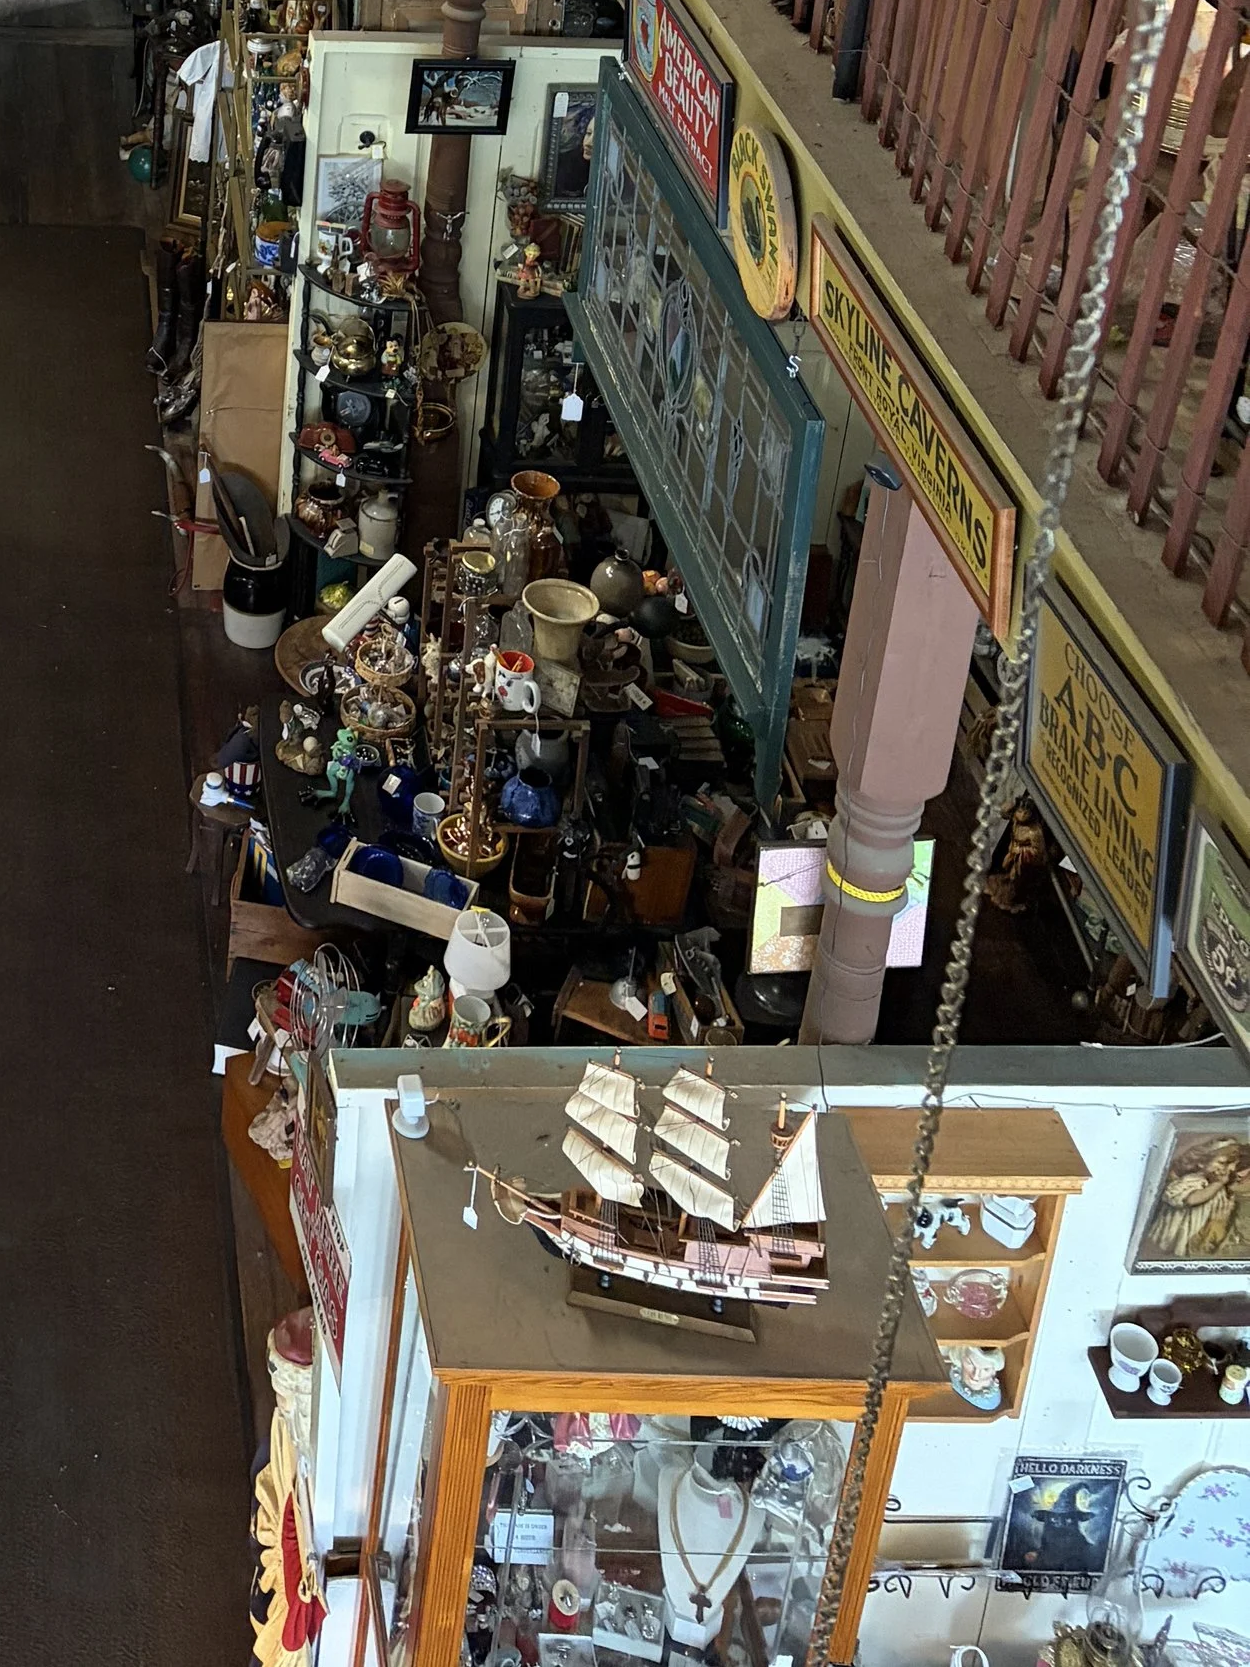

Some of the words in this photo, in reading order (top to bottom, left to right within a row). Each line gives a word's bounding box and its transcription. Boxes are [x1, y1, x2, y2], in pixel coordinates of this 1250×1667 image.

[657, 81, 675, 120] MALT
[676, 110, 713, 181] EXTRACT
[658, 7, 720, 127] AMERICAN
[664, 50, 713, 148] BEAUTY
[731, 132, 759, 180] BLACK
[760, 162, 779, 268] SWAN
[824, 279, 893, 388] SKYLINE
[897, 371, 988, 571] CAVERNS
[848, 341, 875, 392] FRONT
[909, 434, 952, 521] VIRGINIA
[1063, 641, 1135, 760] CHOOSE
[1039, 690, 1090, 796] BRAKE
[1093, 766, 1154, 892] LINING
[1045, 742, 1101, 839] RECOGNIZED
[1105, 832, 1149, 915] LEADER
[1019, 1463, 1058, 1474] HELLO
[1060, 1463, 1121, 1476] DARKNESS
